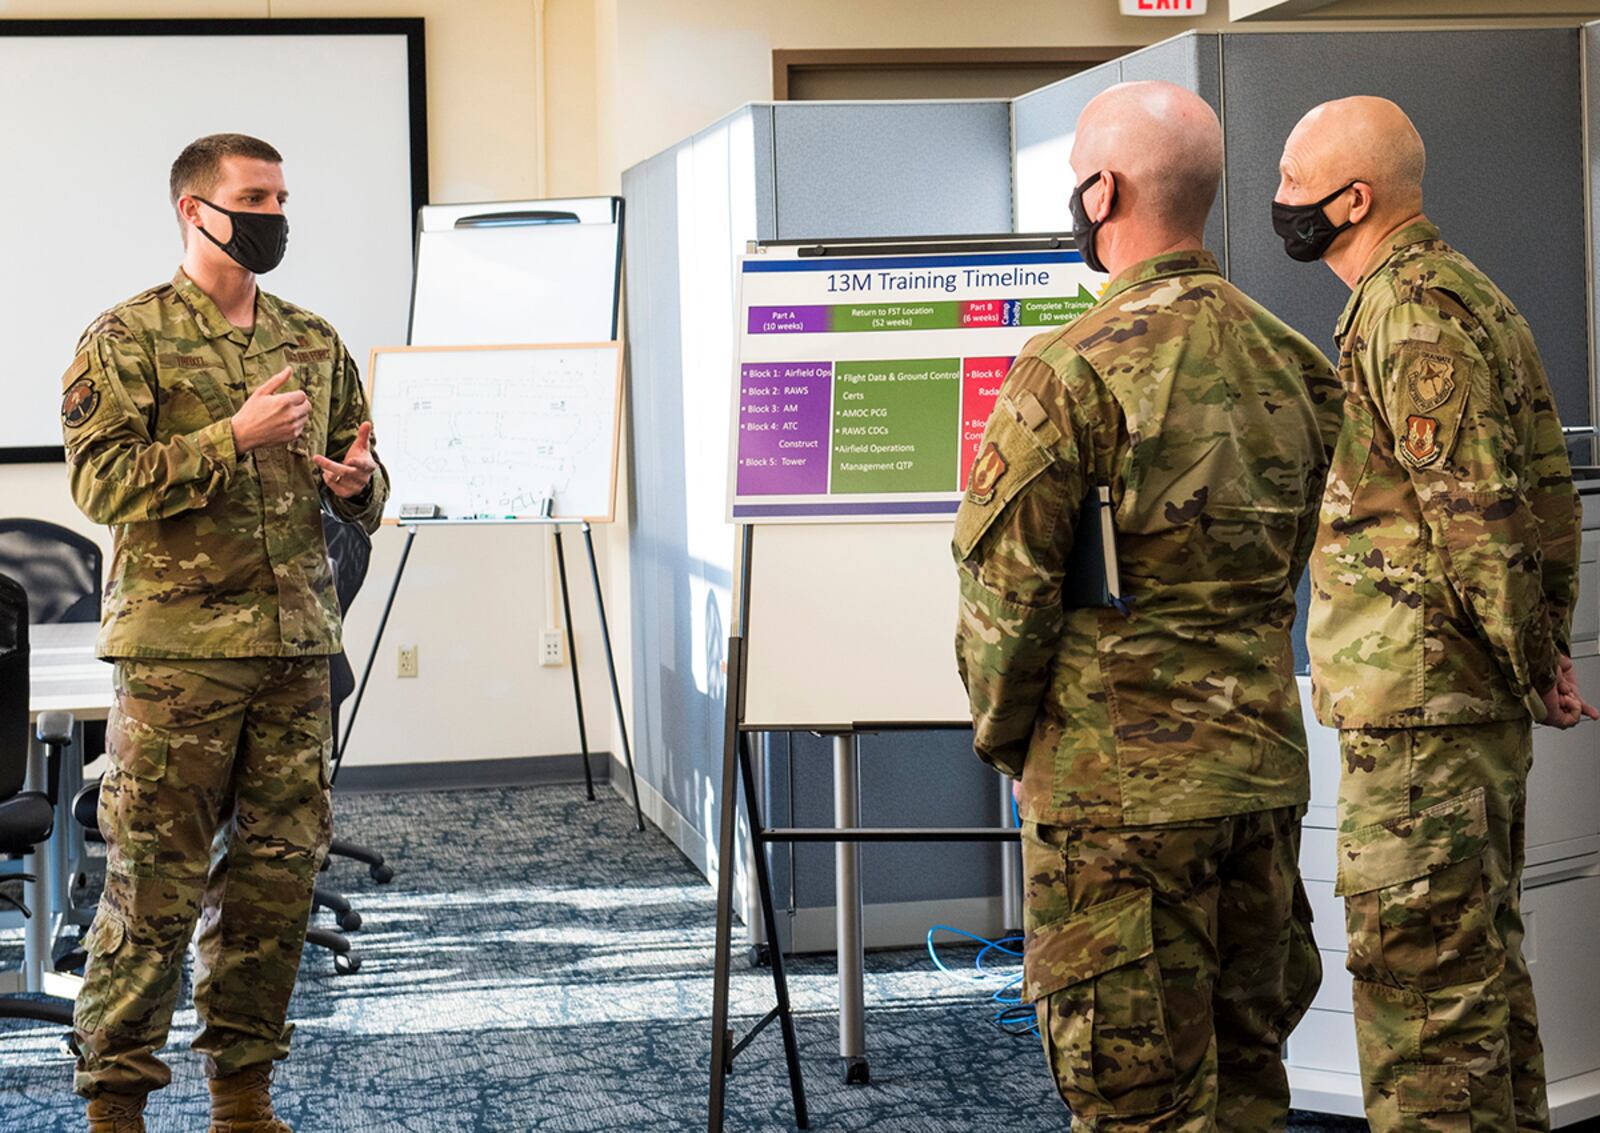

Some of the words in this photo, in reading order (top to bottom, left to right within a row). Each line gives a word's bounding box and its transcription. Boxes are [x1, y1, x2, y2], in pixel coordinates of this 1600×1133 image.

[827, 273, 872, 292] 13M
[878, 271, 957, 293] Training
[963, 268, 1049, 288] Timeline
[970, 303, 986, 311] Part
[987, 302, 993, 310] B
[1025, 302, 1062, 312] Complete
[1064, 301, 1094, 311] Training
[772, 312, 788, 320] Part
[789, 311, 795, 319] A
[851, 308, 876, 317] Return
[878, 308, 886, 316] to
[888, 307, 900, 315] FST
[902, 306, 934, 315] Location
[1001, 303, 1011, 325] Camp
[1012, 301, 1022, 326] Shelby
[963, 314, 971, 323] (6
[972, 313, 999, 323] weeks)
[1039, 312, 1052, 322] (30
[763, 322, 776, 331] (10
[777, 322, 803, 331] weeks)
[872, 318, 885, 327] (52
[886, 317, 912, 327] weeks)
[749, 369, 771, 378] Block
[773, 369, 781, 377] 1:
[785, 368, 814, 377] Airfield
[816, 368, 832, 378] Ops
[844, 373, 866, 384] Flight
[868, 373, 886, 382] Data
[888, 372, 896, 381] &
[897, 371, 928, 381] Ground
[929, 370, 961, 380] Control
[971, 370, 993, 378] Block
[995, 369, 1003, 378] 6:
[748, 387, 770, 395] Block
[772, 387, 780, 395] 2:
[784, 386, 809, 395] RAWS
[978, 387, 1000, 396] Rada
[842, 392, 864, 401] Certs
[747, 405, 770, 413] Block
[772, 405, 779, 413] 3:
[783, 404, 798, 412] AM
[842, 409, 869, 417] AMOC
[870, 408, 887, 417] PCG
[747, 423, 769, 431] Block
[770, 422, 778, 430] 4:
[782, 422, 798, 430] ATC
[971, 419, 987, 428] Blo
[842, 426, 866, 435] RAWS
[868, 426, 889, 435] CDCs
[964, 432, 984, 440] Cont
[778, 440, 818, 448] Construct
[839, 444, 868, 453] Airfield
[870, 443, 915, 453] Operations
[745, 458, 768, 466] Block
[769, 457, 777, 466] 5:
[781, 457, 806, 466] Tower
[840, 462, 894, 472] Management
[896, 460, 913, 470] QTP
